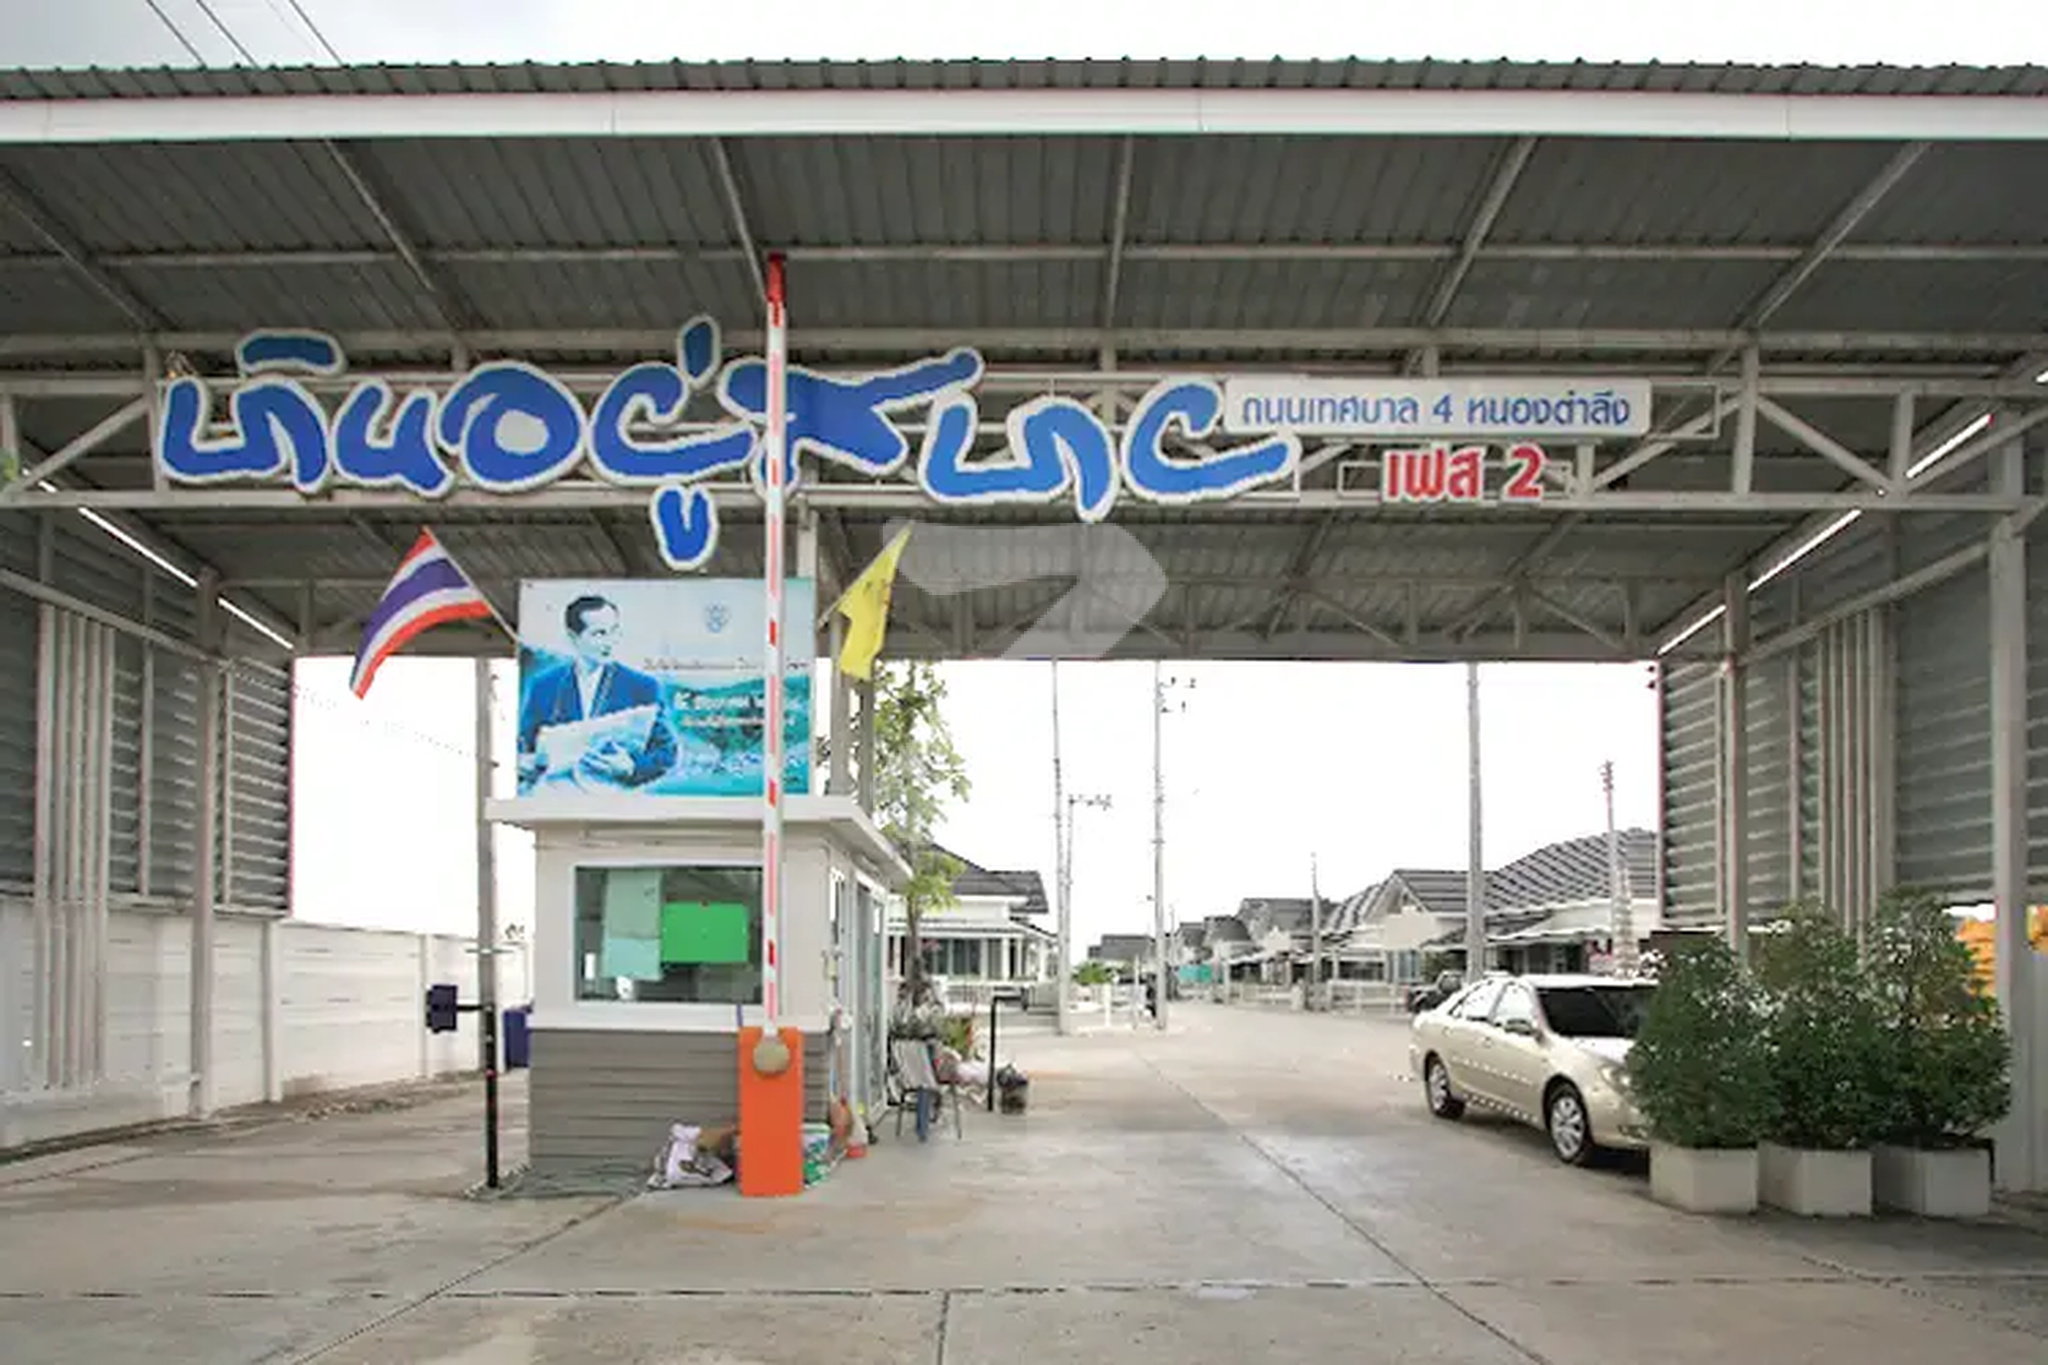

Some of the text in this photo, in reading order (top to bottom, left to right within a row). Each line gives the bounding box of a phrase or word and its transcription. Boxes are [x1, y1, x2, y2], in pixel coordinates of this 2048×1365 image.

[1242, 395, 1420, 425] ถนนเทศบาล
[1432, 394, 1453, 425] 4
[1384, 443, 1543, 500] เฟส 2
